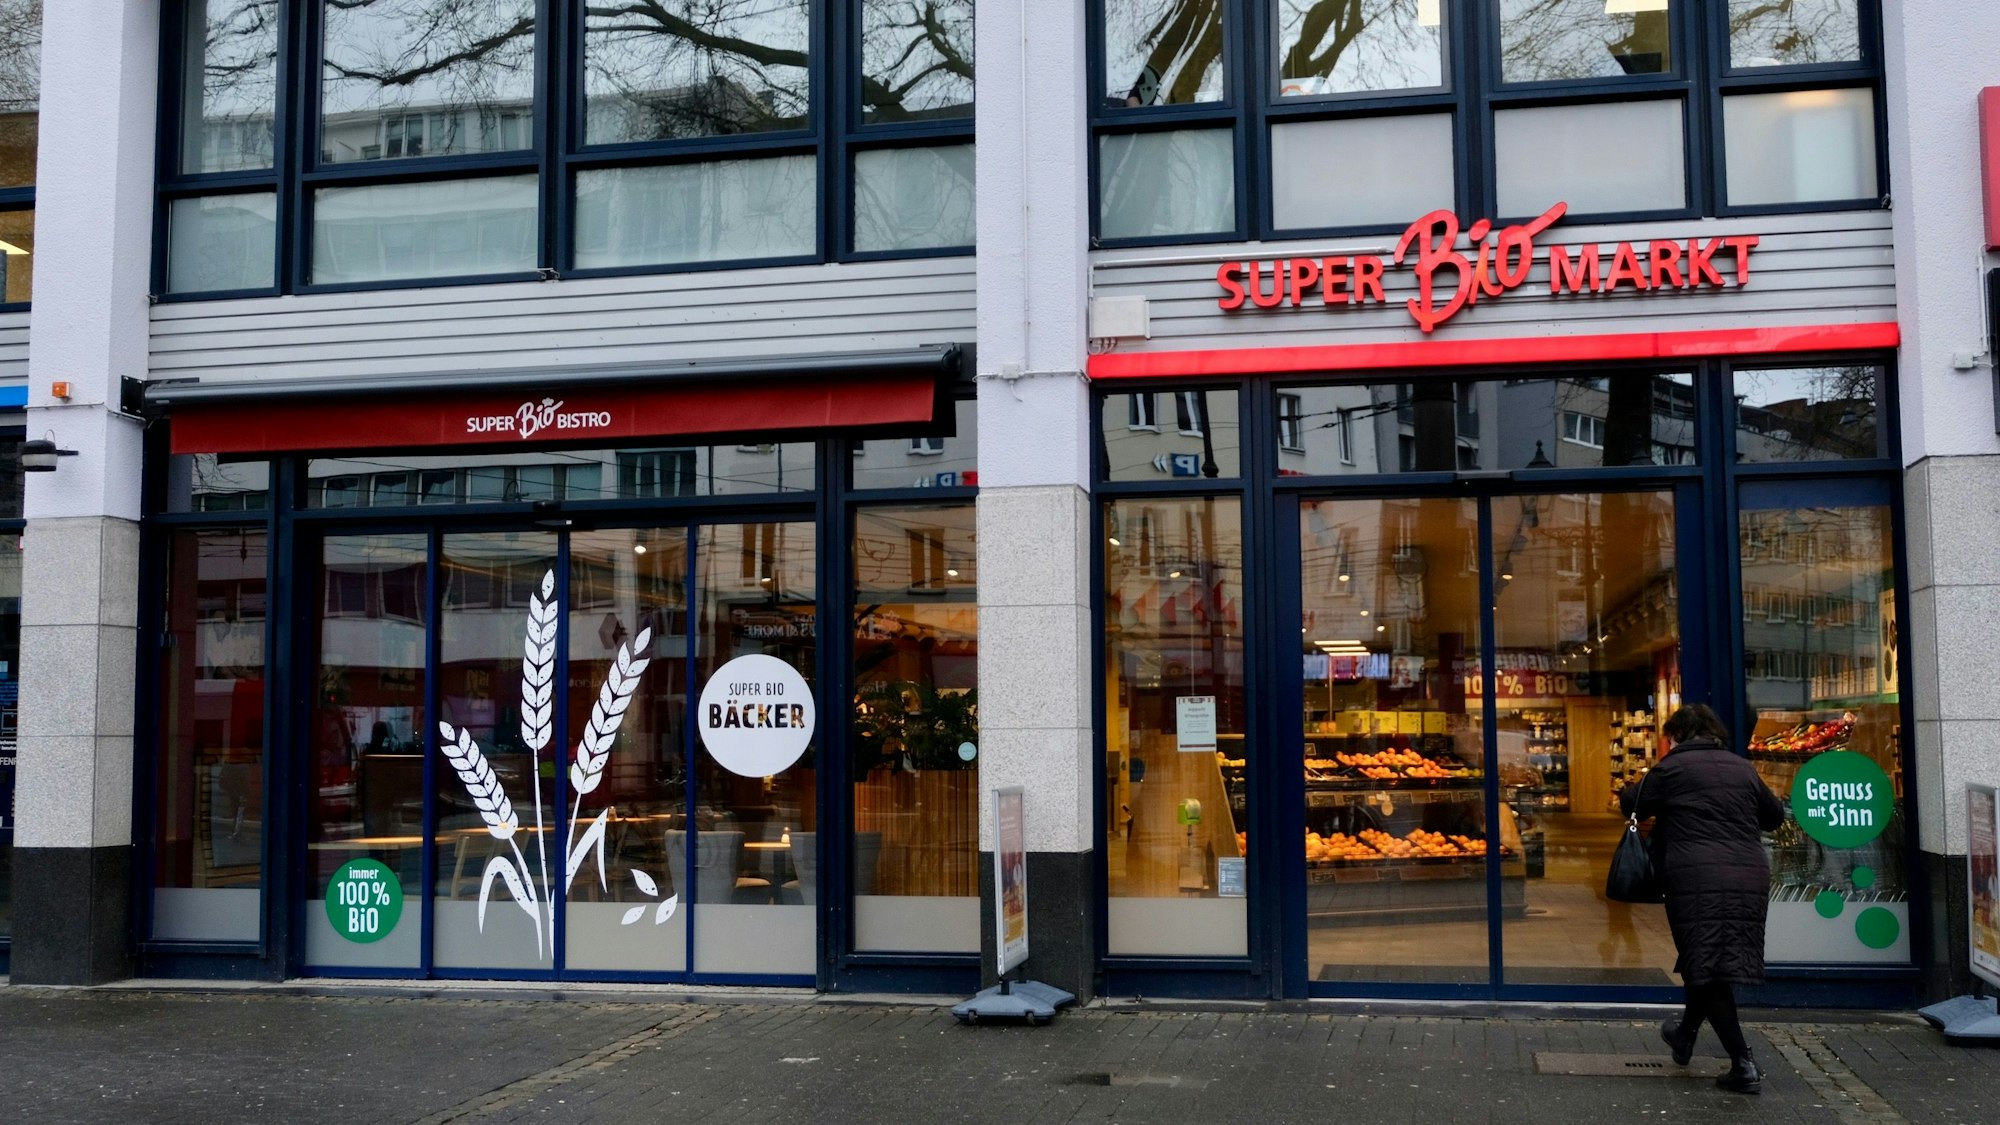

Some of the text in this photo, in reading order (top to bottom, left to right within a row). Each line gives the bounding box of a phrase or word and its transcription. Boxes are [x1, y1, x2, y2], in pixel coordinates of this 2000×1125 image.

[1216, 201, 1760, 333] SUPER Bio MARKT
[466, 399, 612, 439] SUPER Bio BISTRO
[729, 682, 784, 696] SUPER BIO
[1535, 674, 1568, 695] BiO
[709, 699, 805, 729] BÄCKER
[1806, 777, 1873, 801] Genuss
[1808, 803, 1873, 826] mit Sinn
[349, 867, 379, 879] immer
[337, 881, 369, 906] 100
[348, 907, 379, 933] BiO
